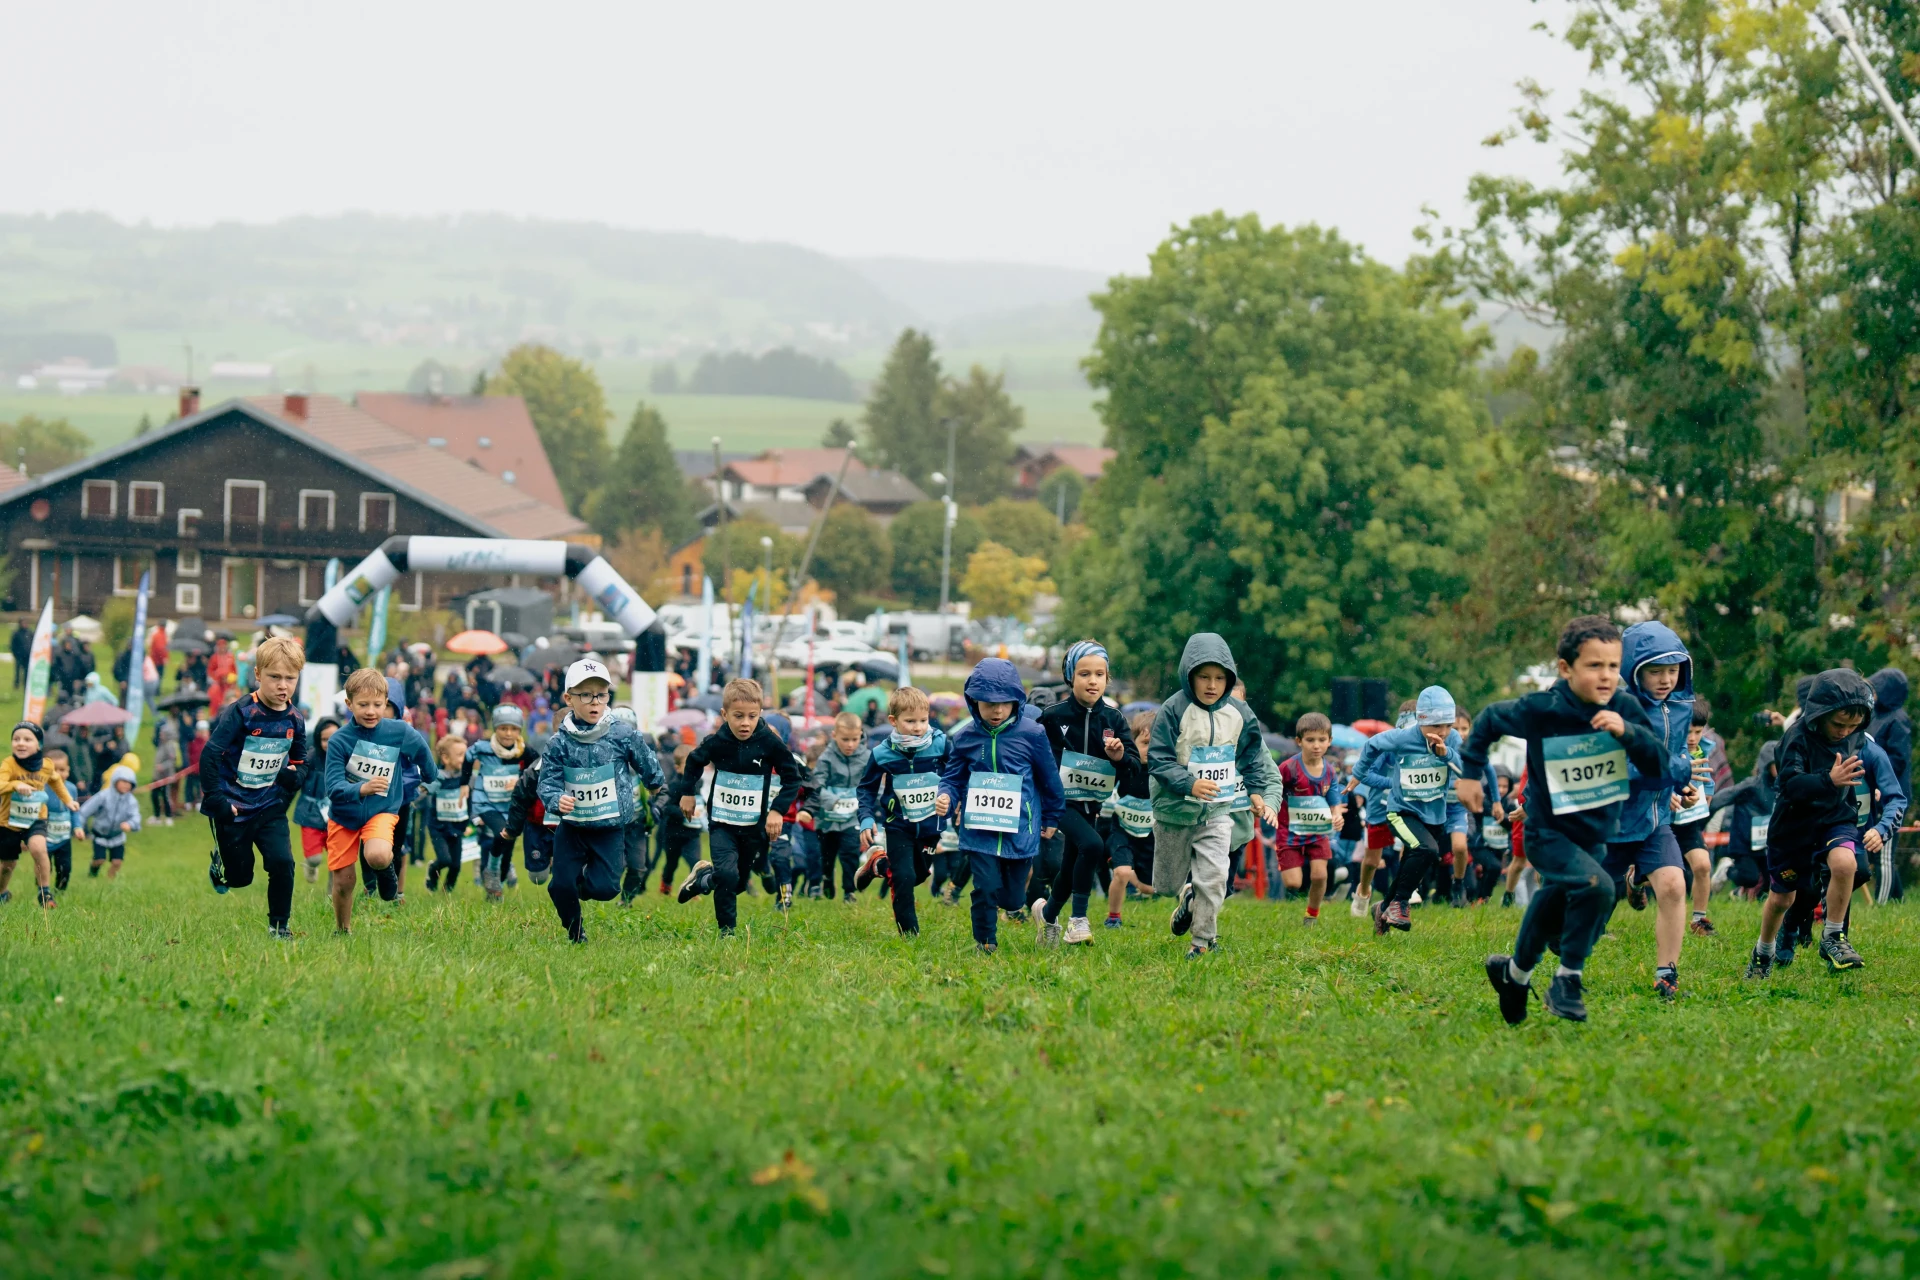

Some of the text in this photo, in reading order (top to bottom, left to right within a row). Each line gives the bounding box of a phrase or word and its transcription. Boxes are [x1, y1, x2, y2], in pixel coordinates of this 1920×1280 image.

[250, 758, 281, 770] 13135
[357, 762, 390, 777] 13113
[1197, 768, 1229, 781] 13051
[1408, 772, 1441, 784] 13016
[1561, 760, 1616, 783] 13072
[1068, 773, 1106, 788] 13144
[571, 786, 608, 802] 13112
[720, 792, 755, 806] 13015
[902, 791, 936, 804] 13023
[975, 795, 1014, 810] 13102
[1121, 811, 1151, 824] 13096
[1296, 812, 1326, 821] 13074
